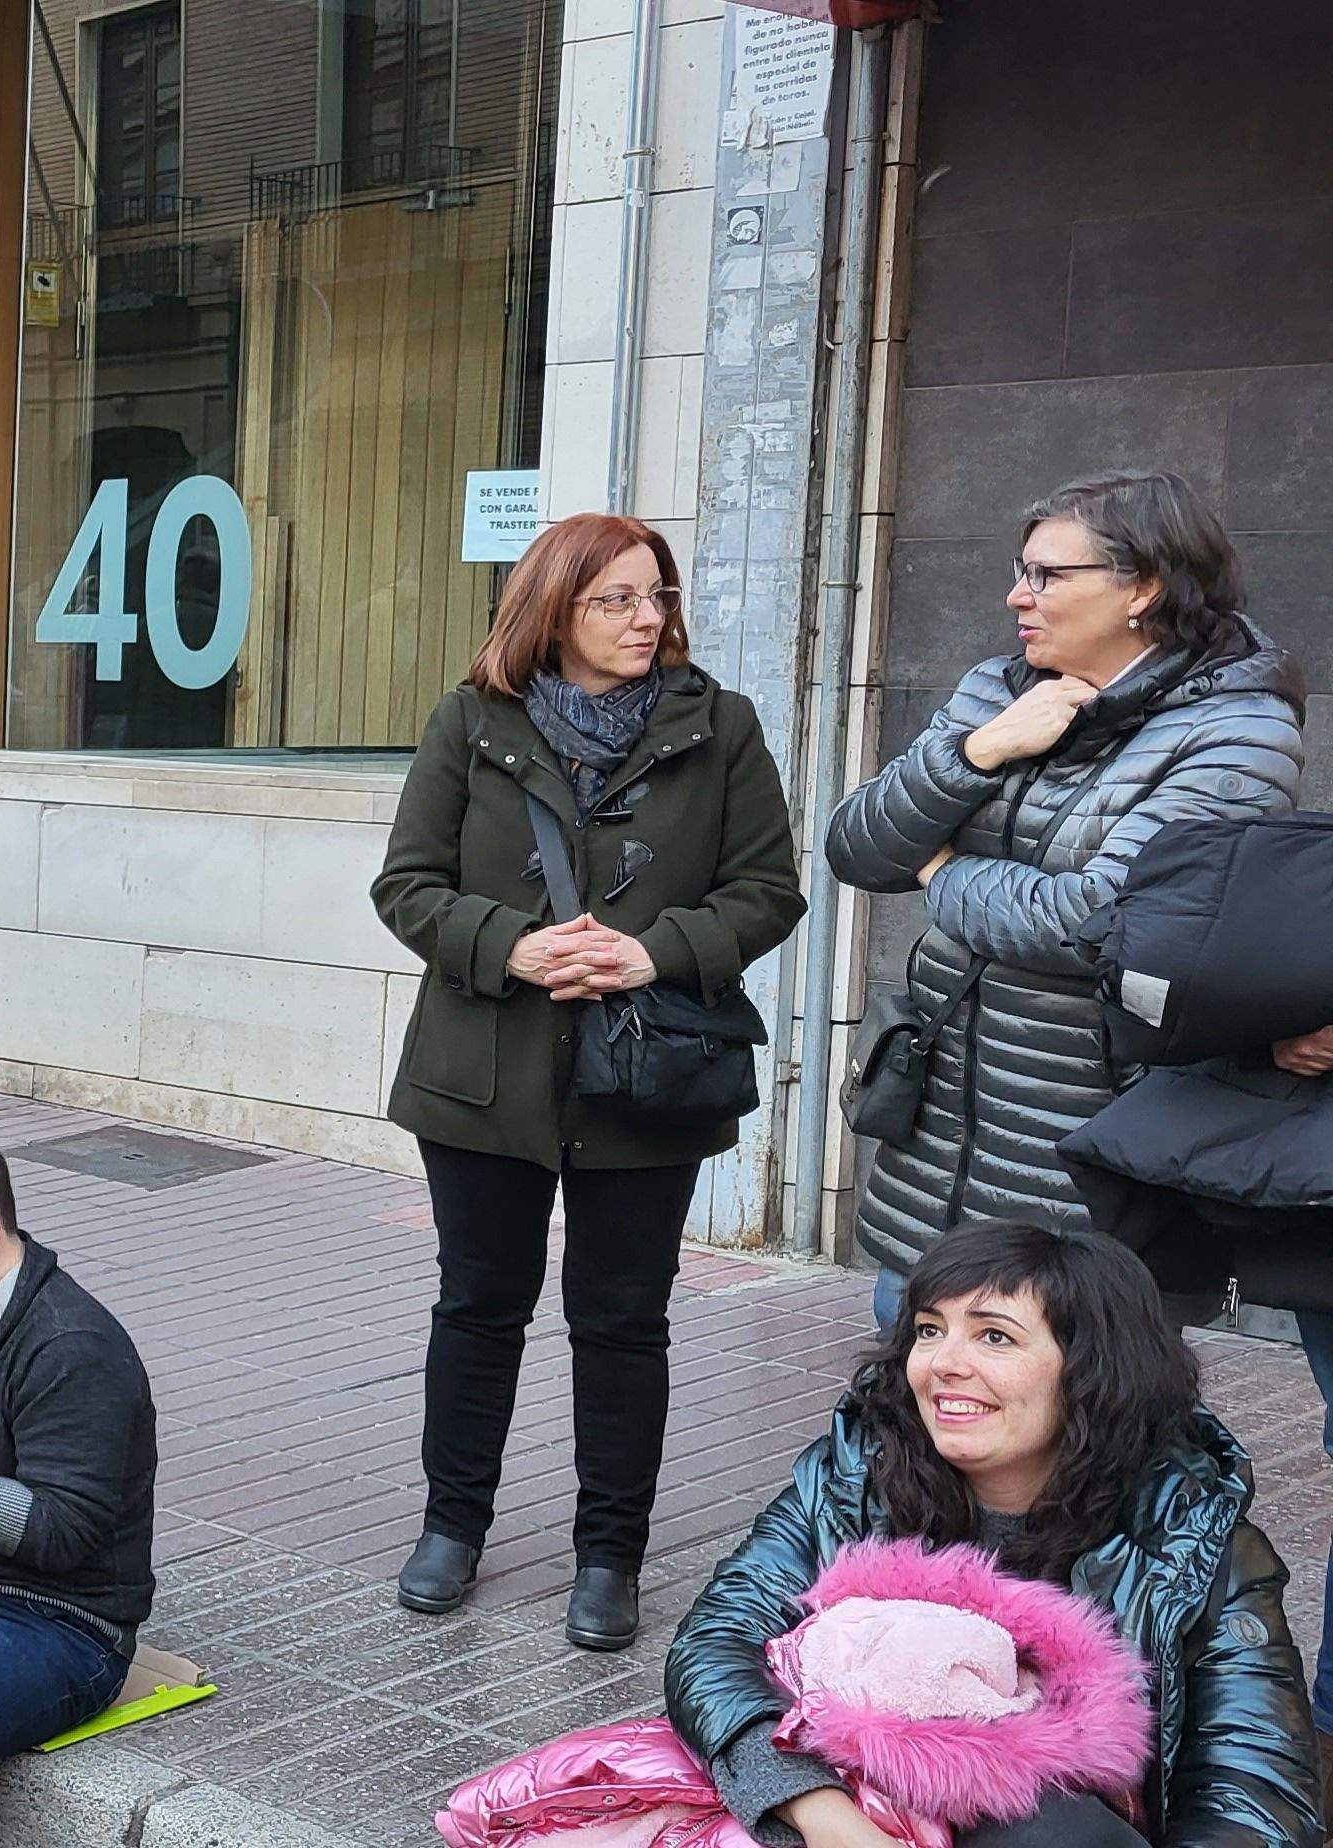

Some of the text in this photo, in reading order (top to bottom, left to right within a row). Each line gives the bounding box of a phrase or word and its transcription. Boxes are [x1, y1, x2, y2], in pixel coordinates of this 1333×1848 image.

[745, 30, 829, 55] figurado nunca
[753, 30, 767, 40] de
[769, 28, 784, 37] no
[742, 43, 831, 69] entre la clientela
[755, 59, 817, 80] especial de
[755, 73, 818, 92] las corridas
[762, 89, 811, 105] de toros.
[479, 488, 492, 497] SE
[495, 487, 530, 496] VENDE
[479, 503, 538, 513] CON GARAJ
[489, 520, 537, 529] TRASTER
[35, 474, 252, 690] 40
